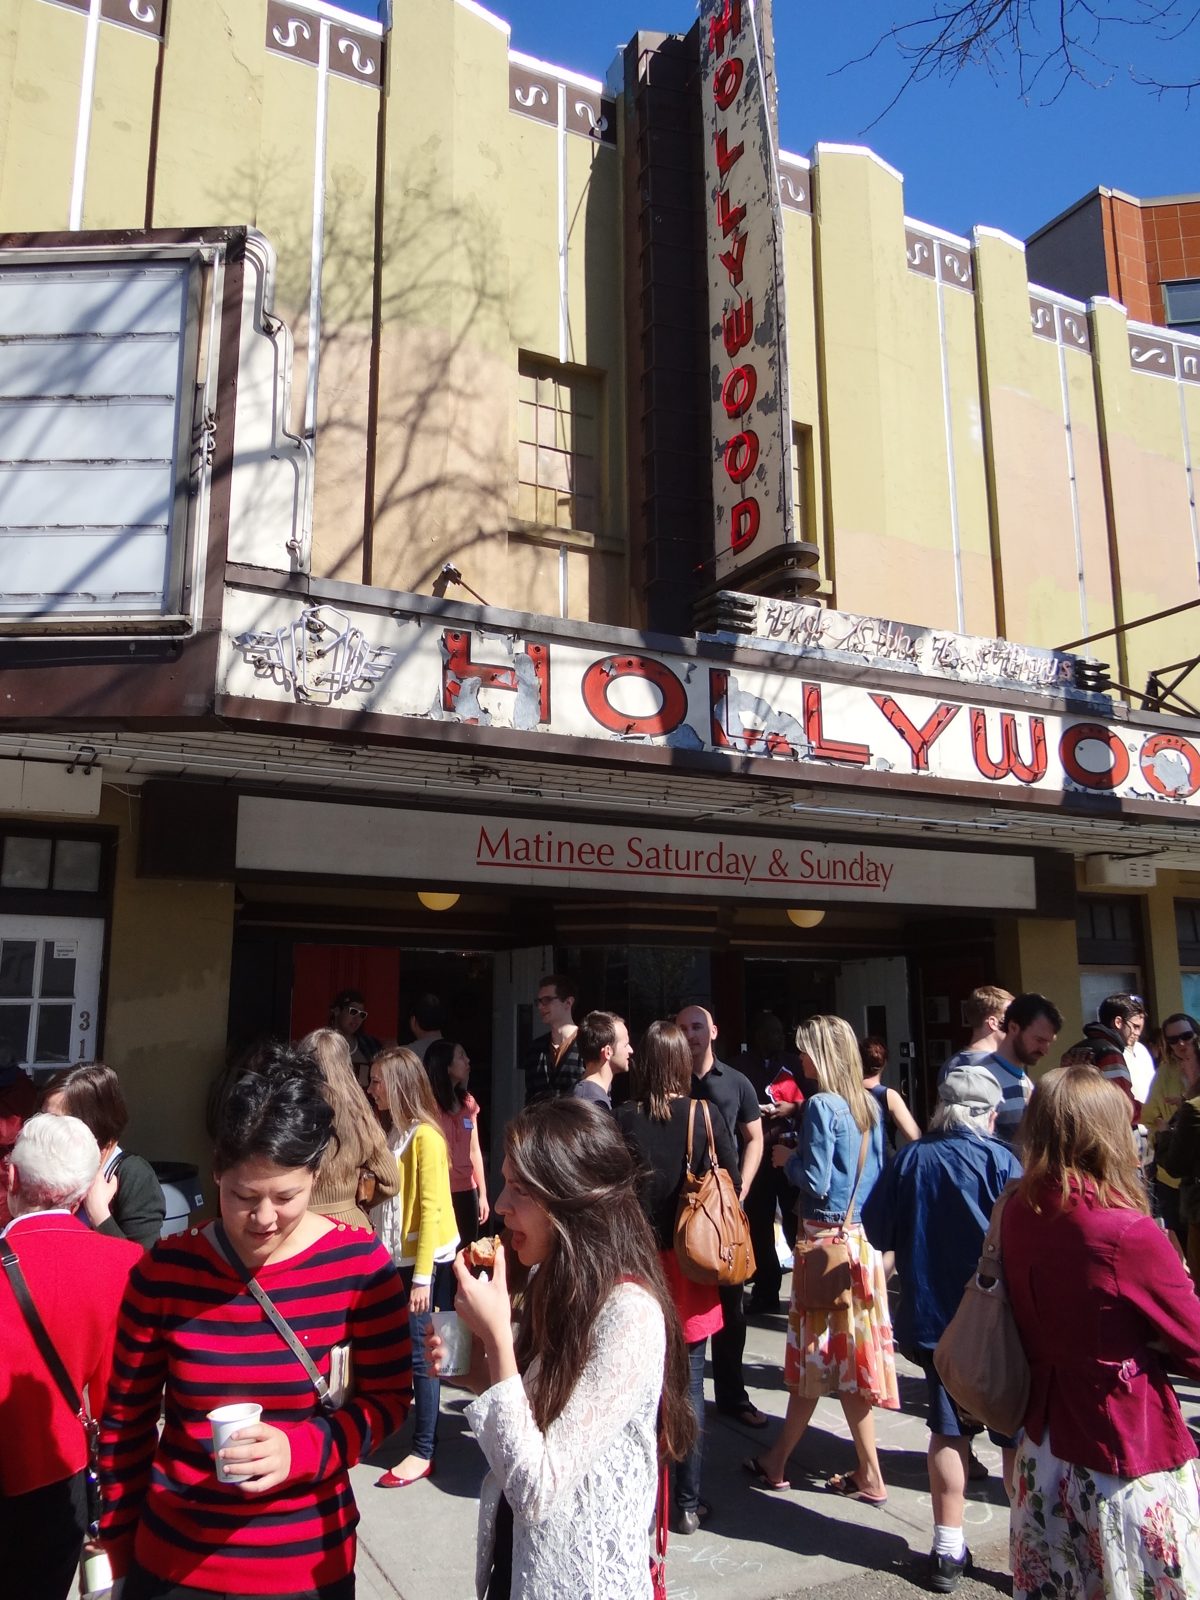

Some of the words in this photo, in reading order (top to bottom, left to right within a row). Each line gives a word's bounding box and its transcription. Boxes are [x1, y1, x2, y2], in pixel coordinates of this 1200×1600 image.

[708, 0, 761, 556] HOLLYWOOD
[476, 825, 614, 866] Matinee
[626, 837, 757, 885] Saturday
[768, 848, 789, 877] &
[800, 849, 894, 892] Sunday
